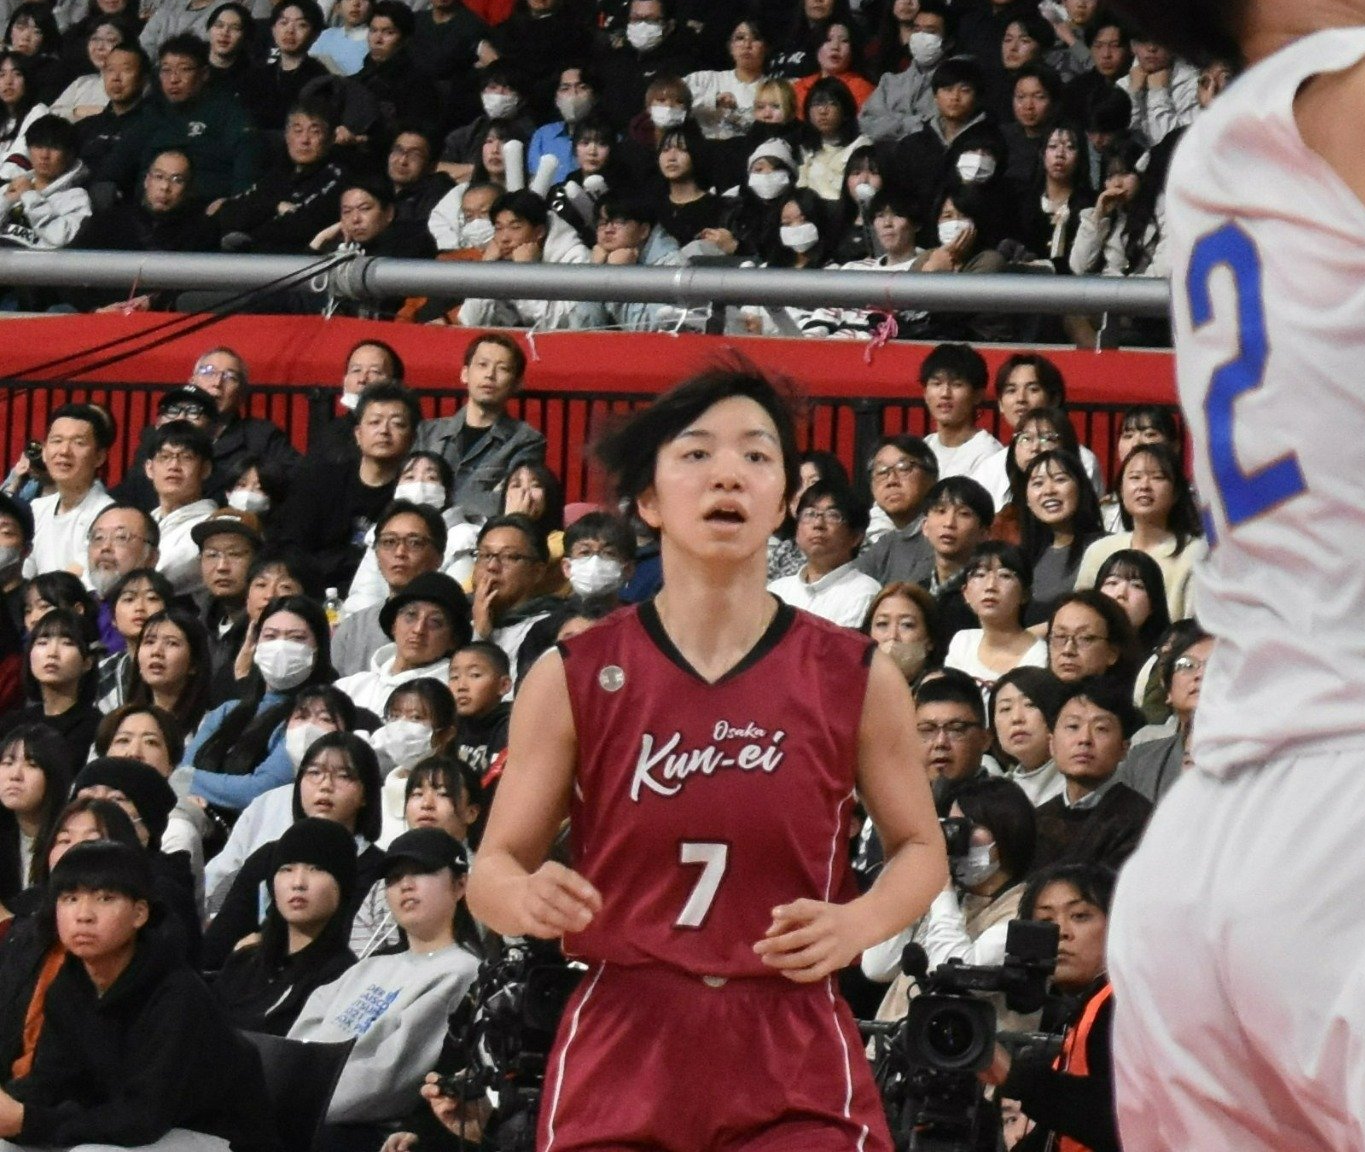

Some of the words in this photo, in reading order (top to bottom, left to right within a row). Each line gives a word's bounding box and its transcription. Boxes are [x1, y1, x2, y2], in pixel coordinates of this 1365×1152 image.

[630, 730, 786, 802] Kun-ei
[713, 719, 767, 741] Osaka
[677, 843, 729, 928] 7
